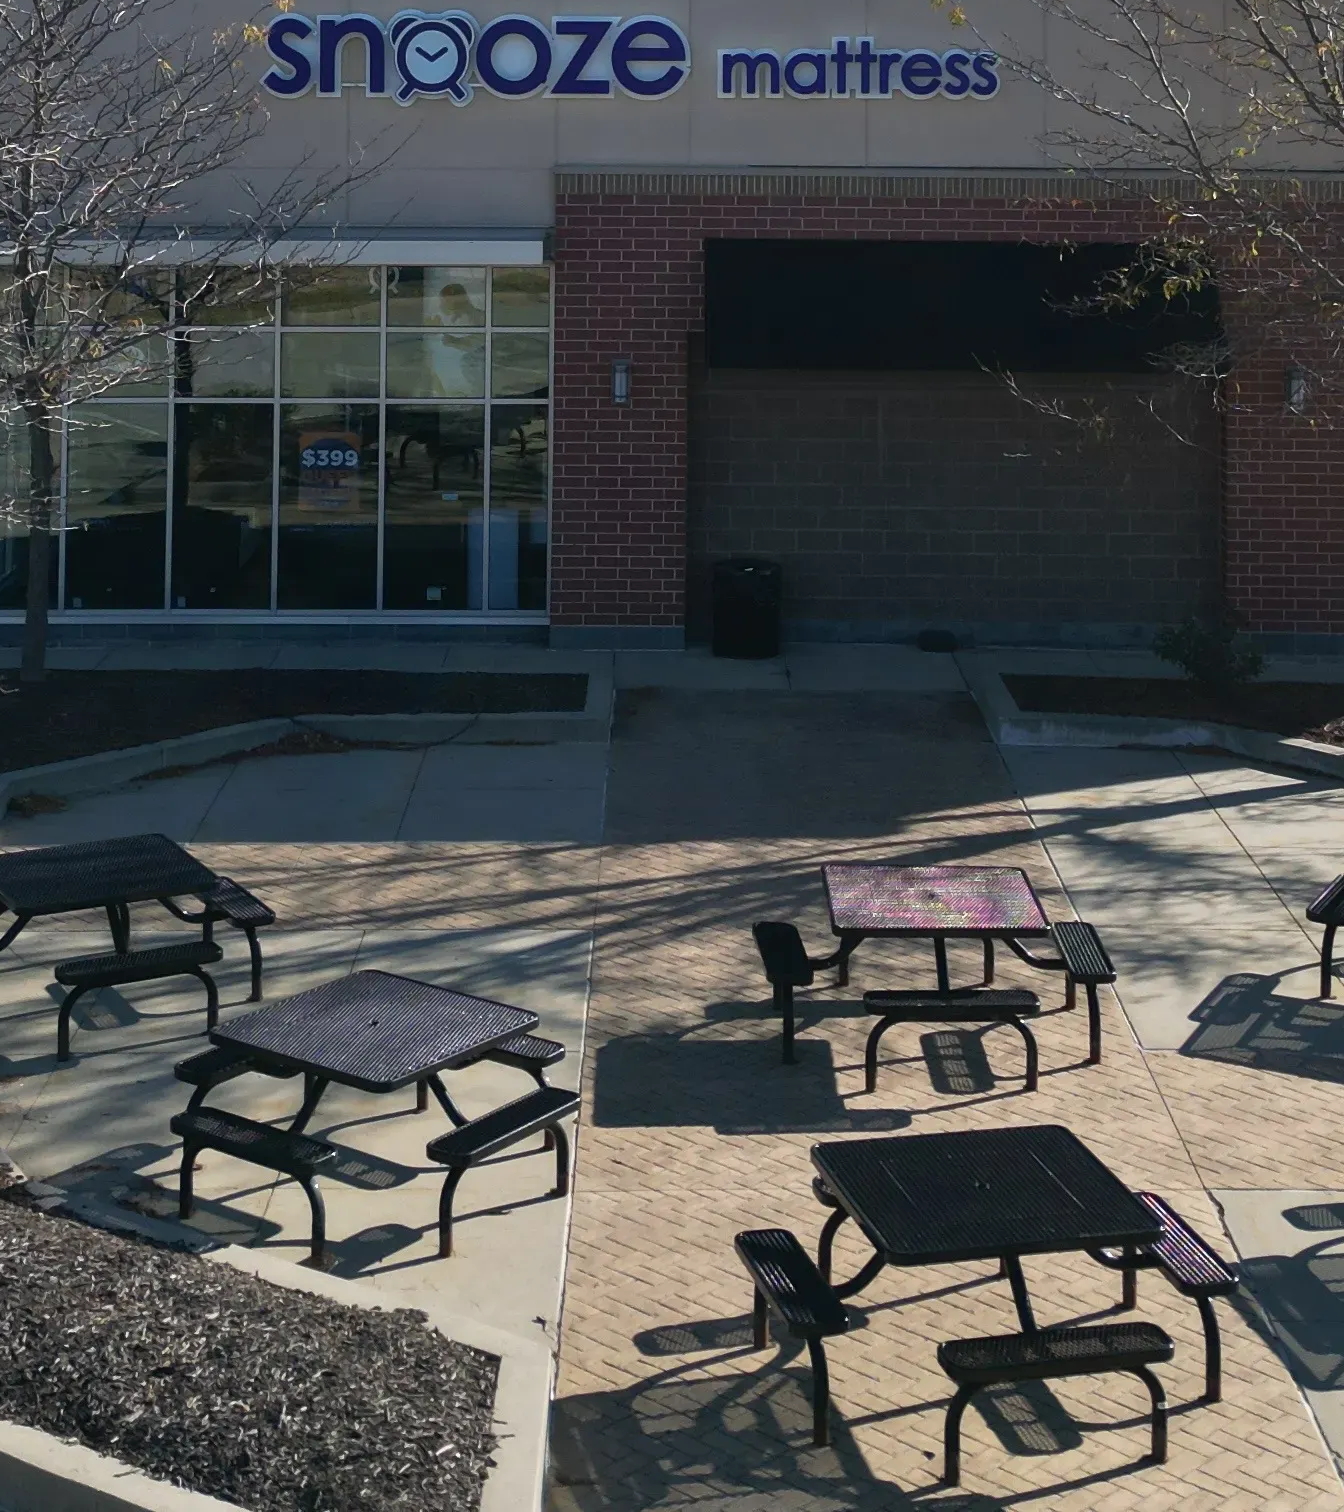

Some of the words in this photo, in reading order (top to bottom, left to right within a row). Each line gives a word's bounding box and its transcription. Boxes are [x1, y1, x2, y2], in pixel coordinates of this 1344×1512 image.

[261, 12, 689, 101] snooze
[721, 39, 1001, 98] mattress
[301, 448, 359, 468] $399
